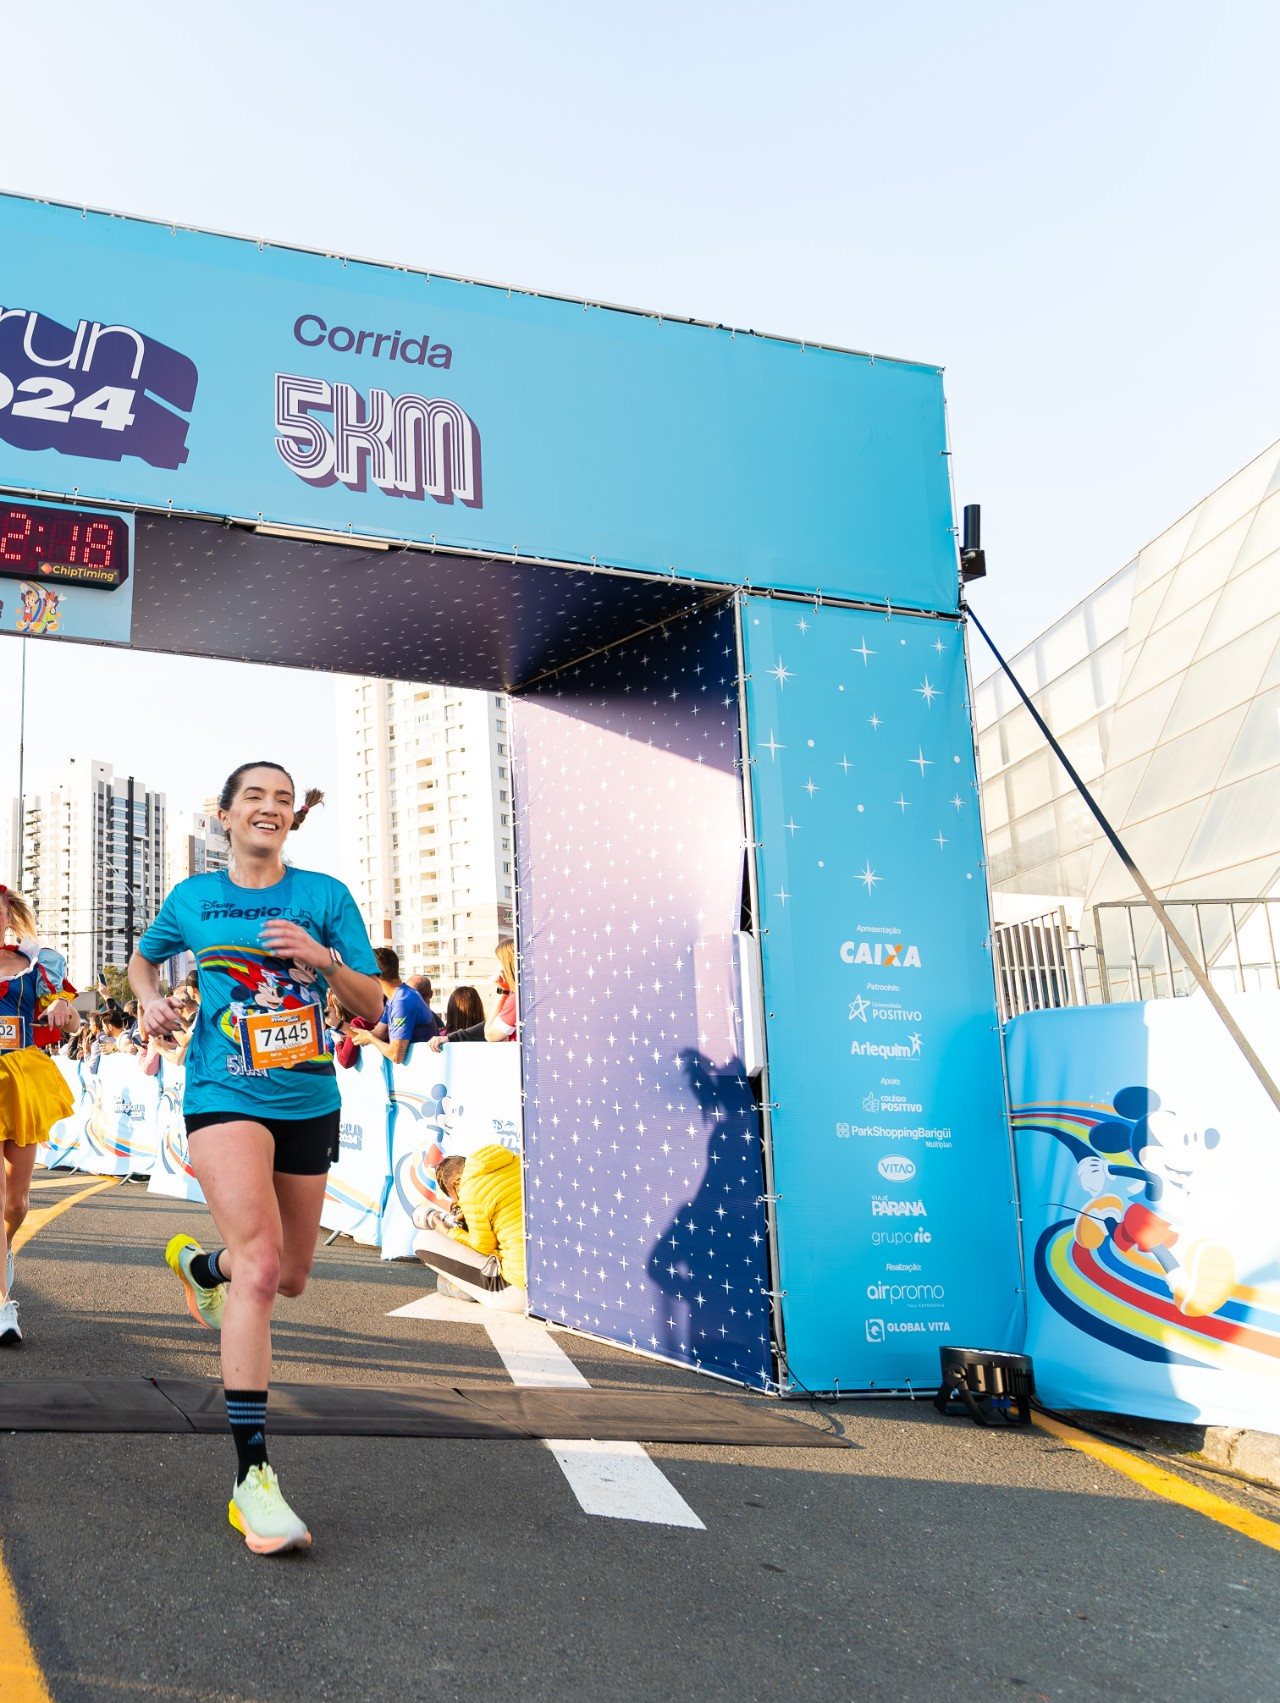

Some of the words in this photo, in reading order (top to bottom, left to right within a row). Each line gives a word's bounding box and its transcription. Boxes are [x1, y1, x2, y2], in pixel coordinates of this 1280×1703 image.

[293, 313, 453, 370] Corrida
[840, 940, 922, 968] CAIXA
[872, 1009, 923, 1021] POSITIVO
[260, 1022, 309, 1046] 7445
[851, 1040, 911, 1060] Arlequim
[881, 1103, 923, 1113] POSITIVO
[886, 1322, 926, 1333] GLOBAL
[928, 1321, 951, 1332] VITA
